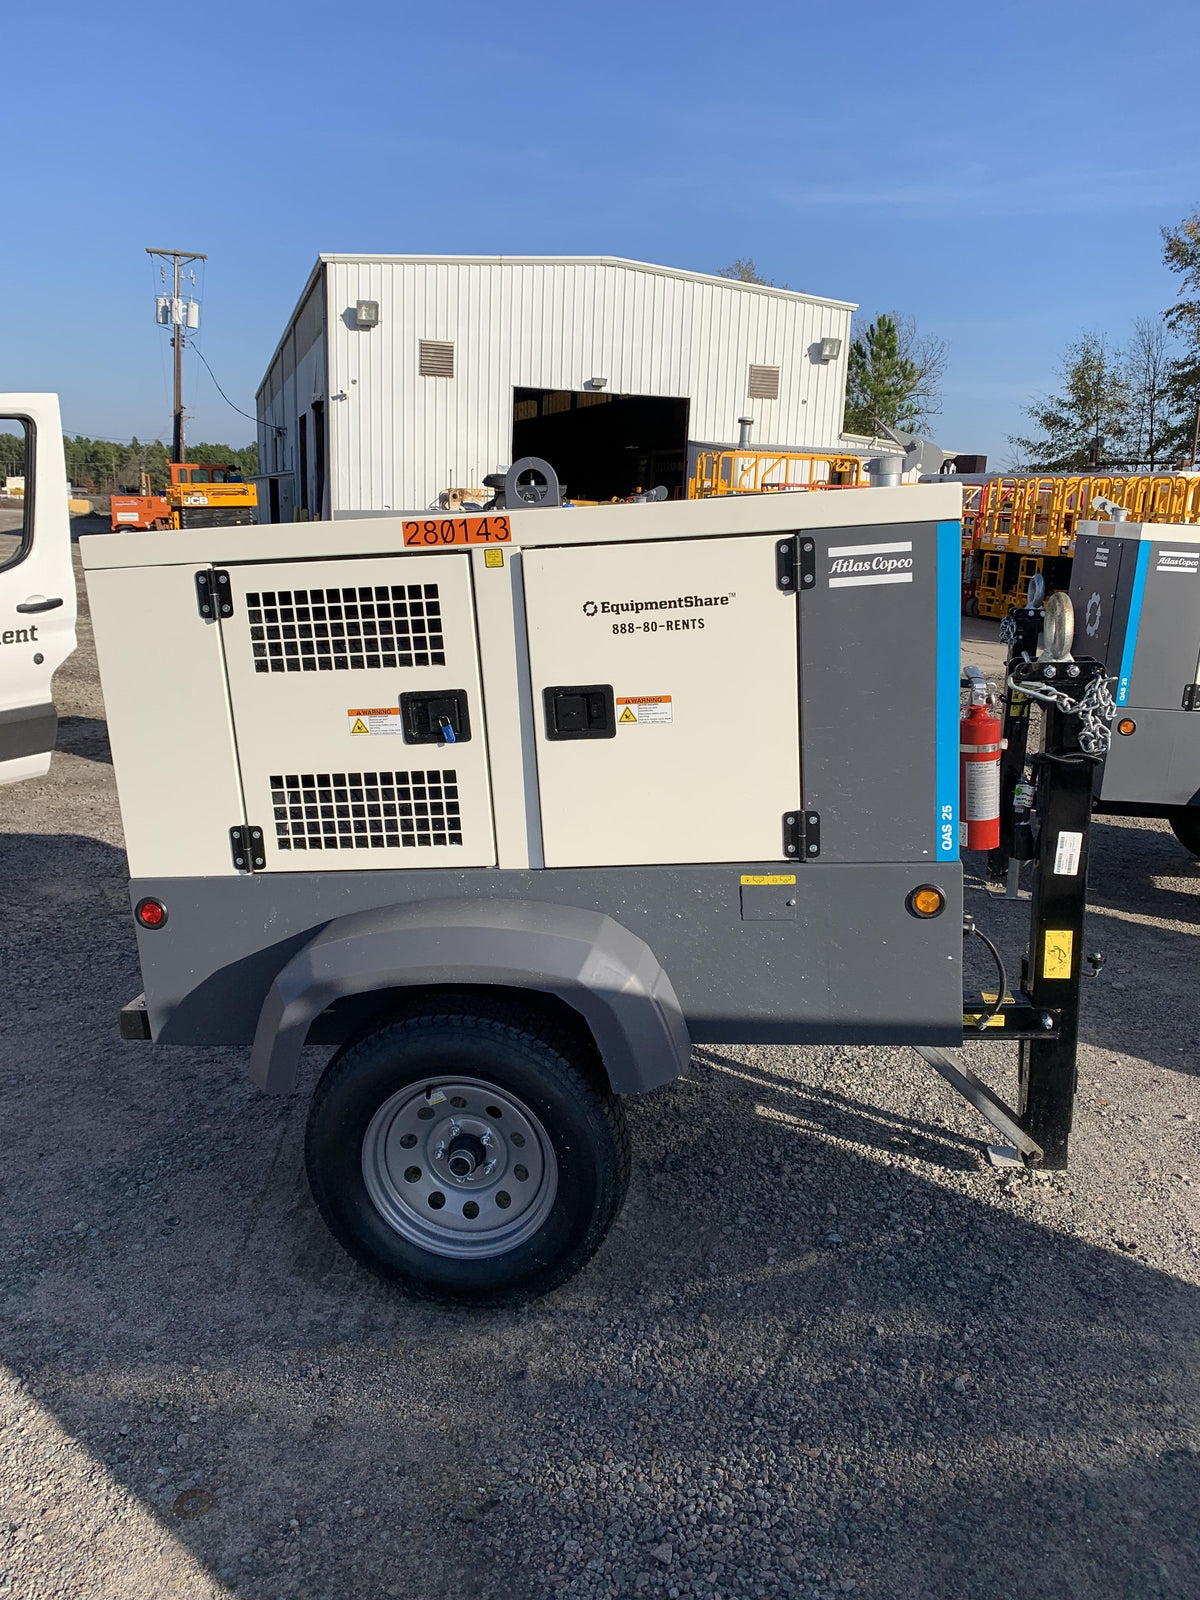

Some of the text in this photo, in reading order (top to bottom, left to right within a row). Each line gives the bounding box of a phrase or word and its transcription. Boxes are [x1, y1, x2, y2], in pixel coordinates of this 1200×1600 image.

[183, 496, 209, 505] JCB
[405, 516, 509, 545] 280143
[828, 556, 913, 573] Atlas Copco
[1157, 556, 1199, 567] Atlas Copco
[601, 595, 729, 615] EquipmentShare
[0, 624, 38, 645] ent
[612, 618, 705, 634] 888-80-RENTS
[361, 708, 392, 716] WARNING
[941, 804, 953, 851] QAS 25
